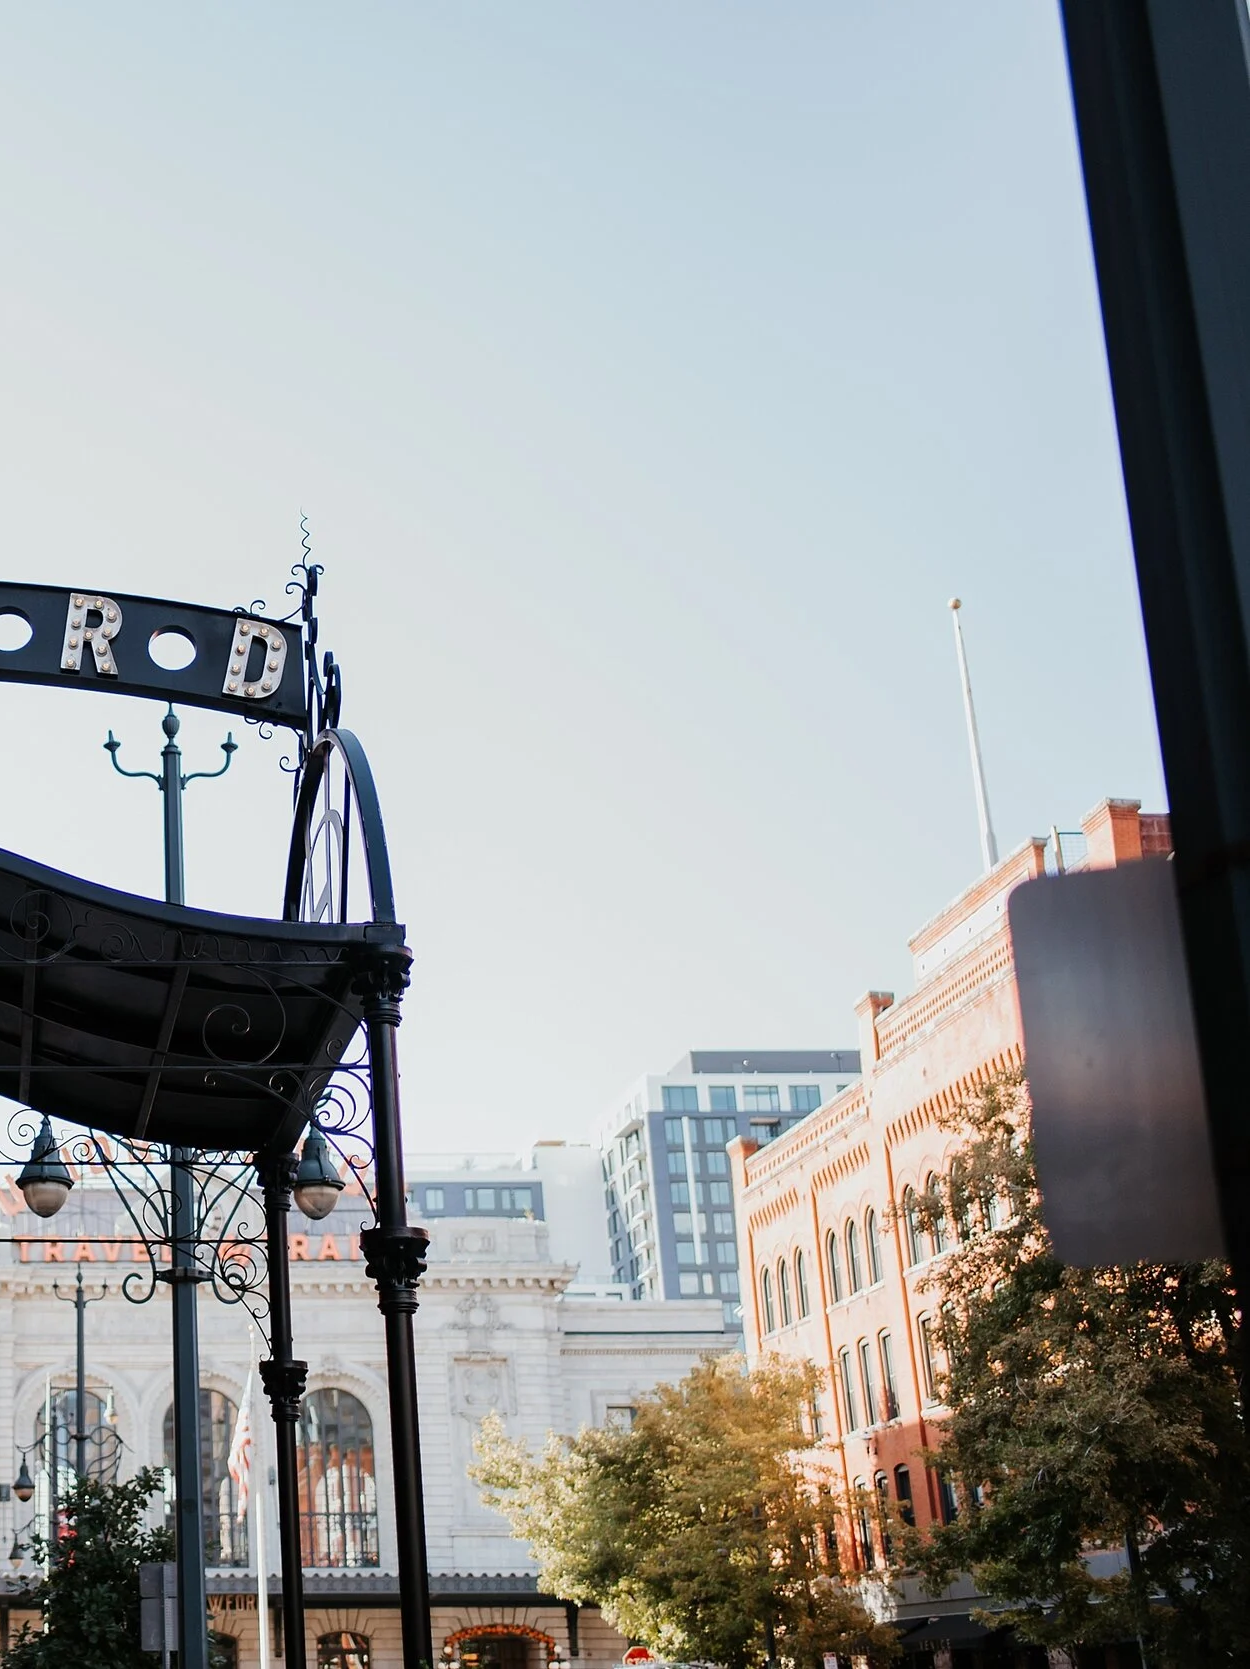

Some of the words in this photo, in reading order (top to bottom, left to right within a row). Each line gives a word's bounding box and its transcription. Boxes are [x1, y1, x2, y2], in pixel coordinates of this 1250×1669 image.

[13, 1234, 172, 1263] TRAVEL
[266, 1232, 363, 1261] RAI
[206, 1594, 258, 1615] WFOR
